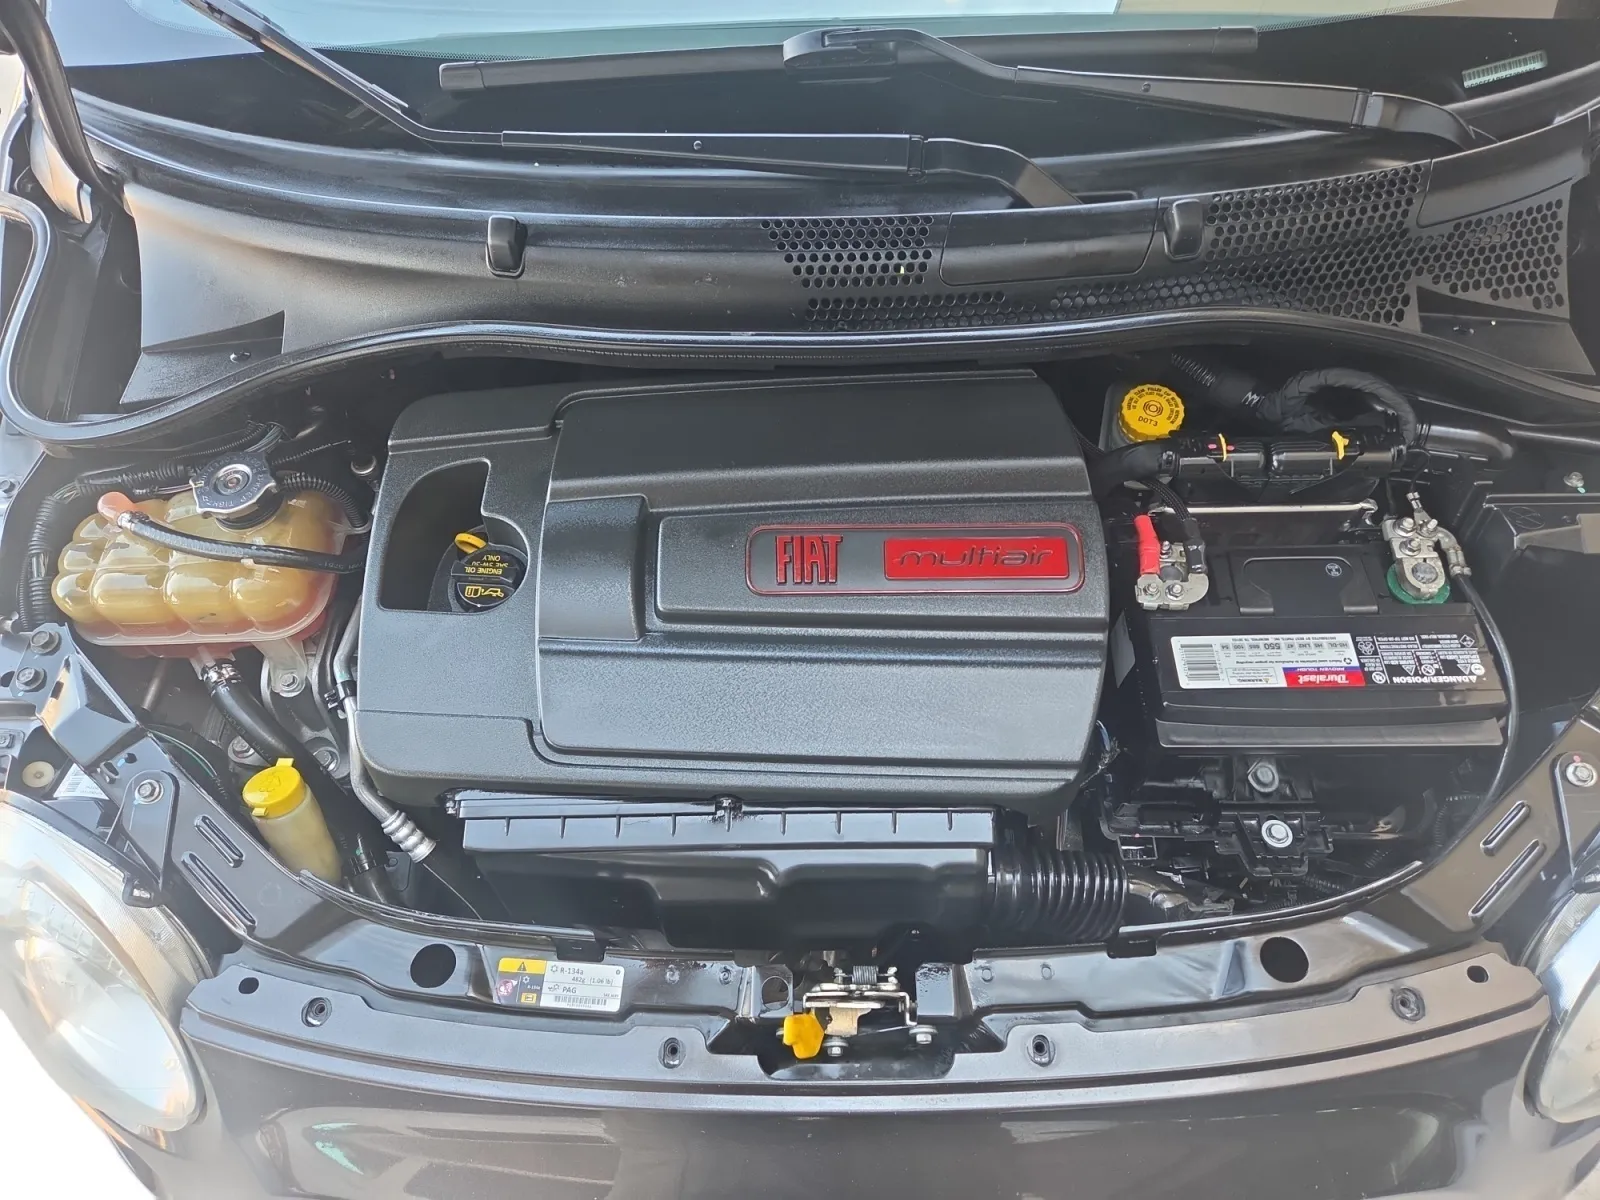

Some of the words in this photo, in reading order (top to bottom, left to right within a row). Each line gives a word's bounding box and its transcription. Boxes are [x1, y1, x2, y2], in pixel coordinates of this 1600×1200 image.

[1138, 416, 1158, 427] DOT3
[775, 535, 843, 584] FIAT
[892, 544, 1054, 568] multiair
[1298, 674, 1349, 684] Duralast
[560, 967, 584, 975] R-134a
